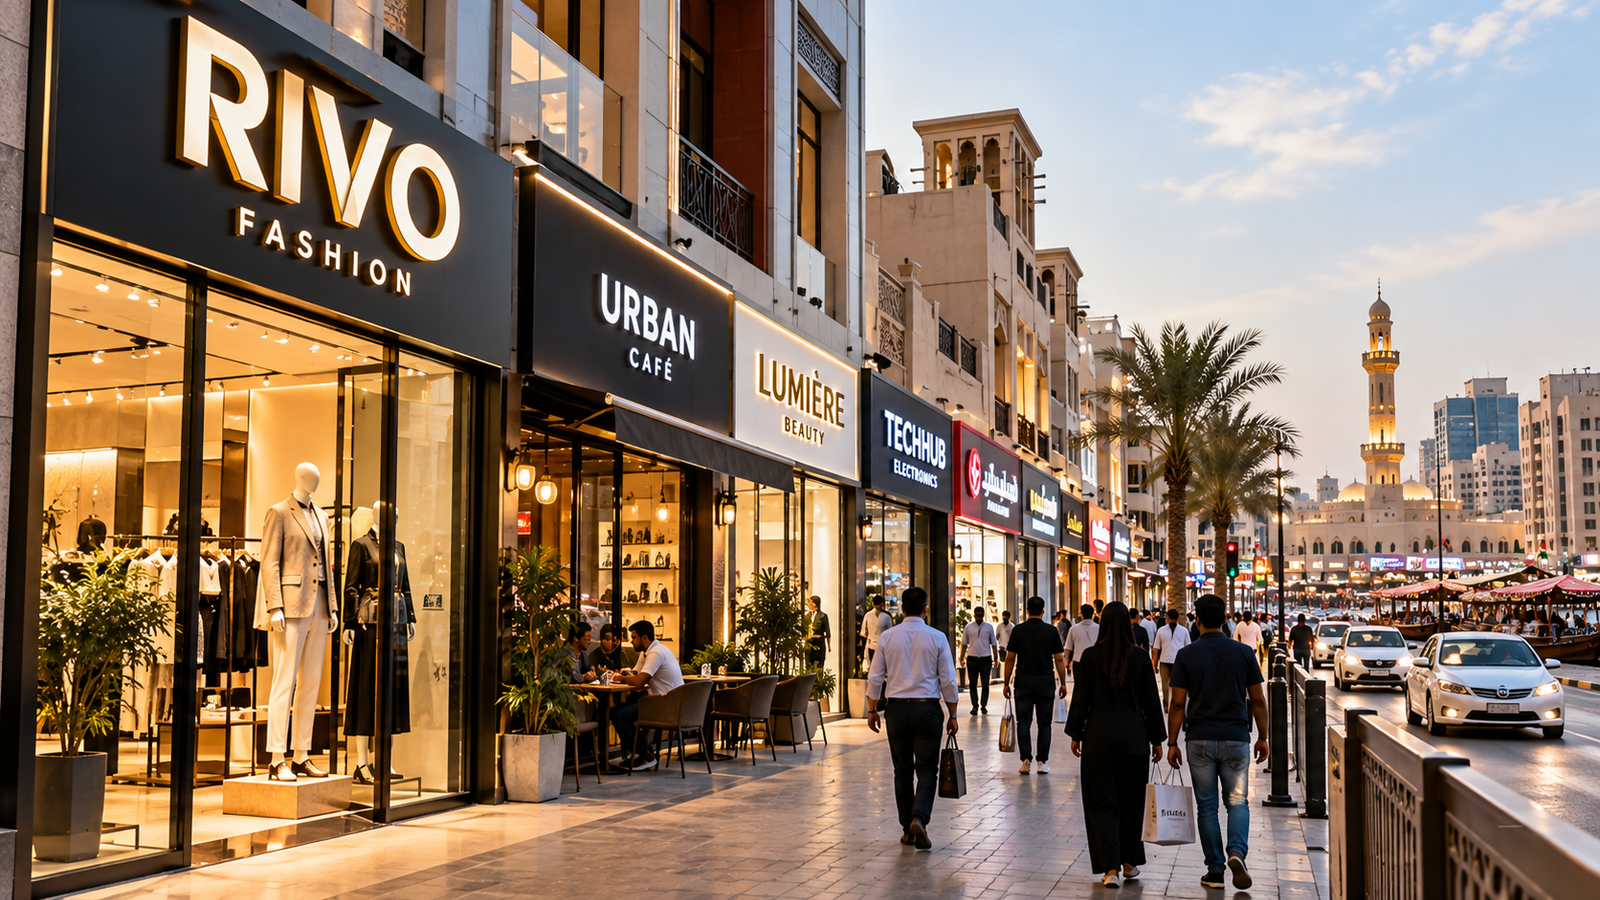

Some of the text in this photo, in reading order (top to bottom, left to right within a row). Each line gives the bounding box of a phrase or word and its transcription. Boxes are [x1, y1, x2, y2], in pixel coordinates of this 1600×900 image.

[176, 15, 461, 262] RIVO
[235, 206, 411, 297] FASHION
[601, 272, 695, 361] URBAN
[629, 347, 672, 382] CAFÉ
[758, 353, 845, 428] LUMIÈRE
[784, 416, 824, 445] BEAUTY
[884, 409, 946, 470] TECHHUB
